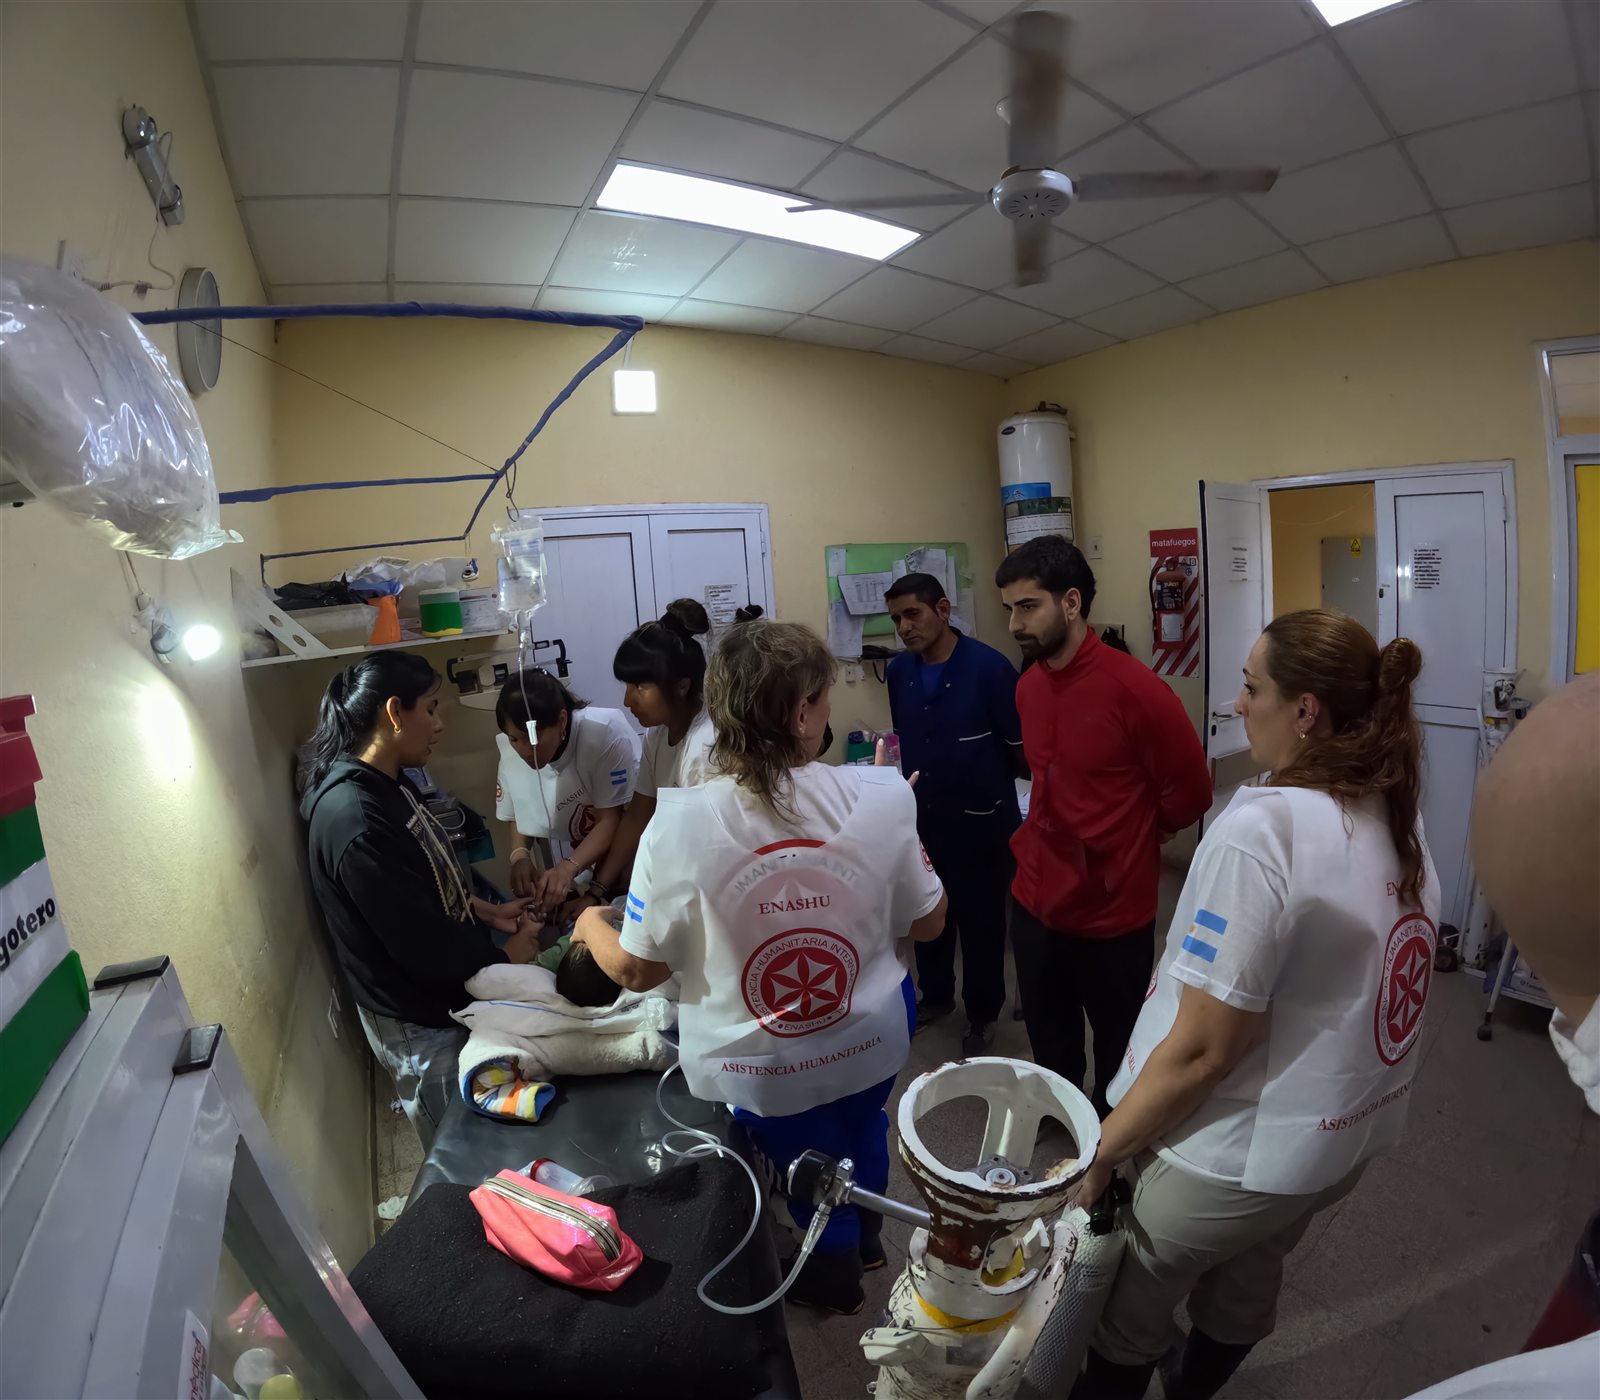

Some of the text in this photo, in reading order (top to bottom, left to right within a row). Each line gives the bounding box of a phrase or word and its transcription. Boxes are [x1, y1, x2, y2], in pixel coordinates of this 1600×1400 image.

[1151, 538, 1196, 548] matafuegos
[758, 895, 831, 915] ENASHU
[755, 937, 828, 971] HUMANITARIA
[721, 1036, 882, 1076] ASISTENCIA HUMANITARIA
